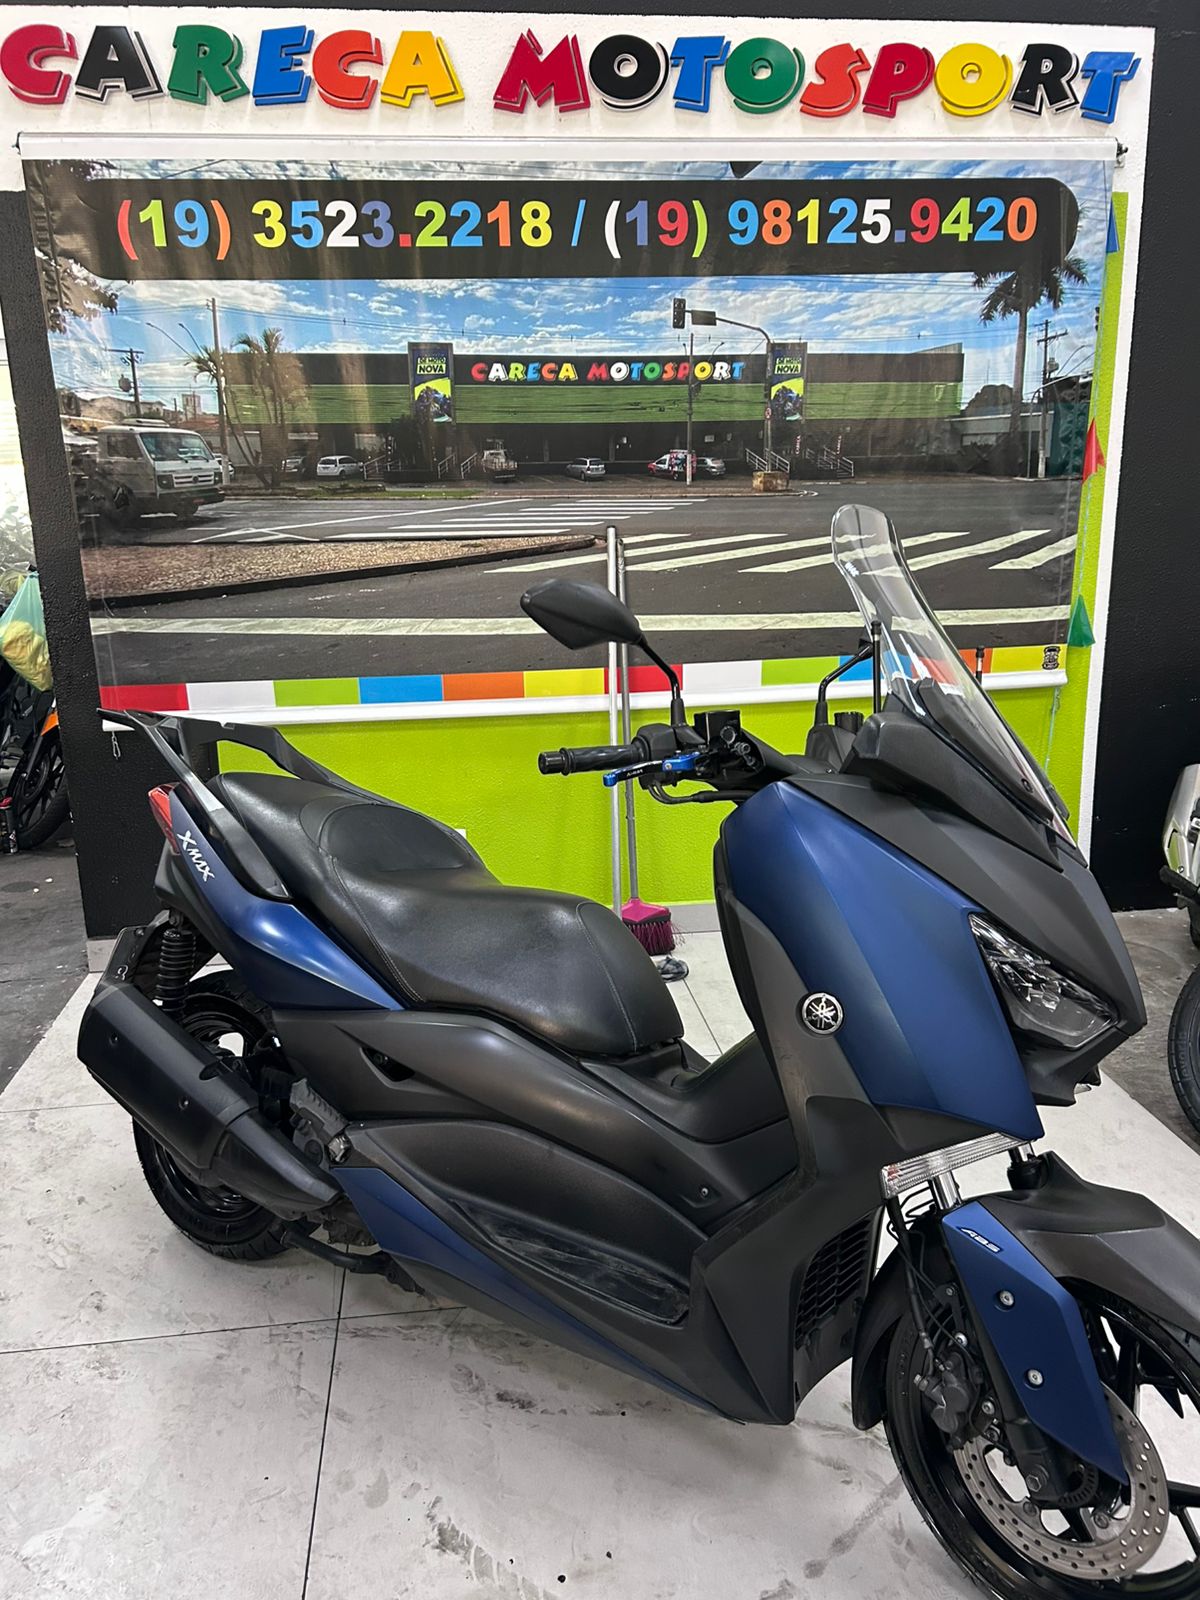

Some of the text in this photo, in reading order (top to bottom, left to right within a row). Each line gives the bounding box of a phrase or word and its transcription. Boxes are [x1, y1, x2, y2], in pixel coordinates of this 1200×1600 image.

[0, 24, 1142, 124] CARECA MOTOSPORT
[117, 199, 231, 260] (19)
[252, 199, 553, 249] 3523.2218
[604, 200, 708, 258] (19)
[728, 197, 1038, 246] 98125.9420
[418, 364, 444, 373] NOVA
[471, 361, 745, 382] CARECA MOTOSPORT
[776, 365, 799, 373] NOVA
[176, 830, 216, 882] XMAX
